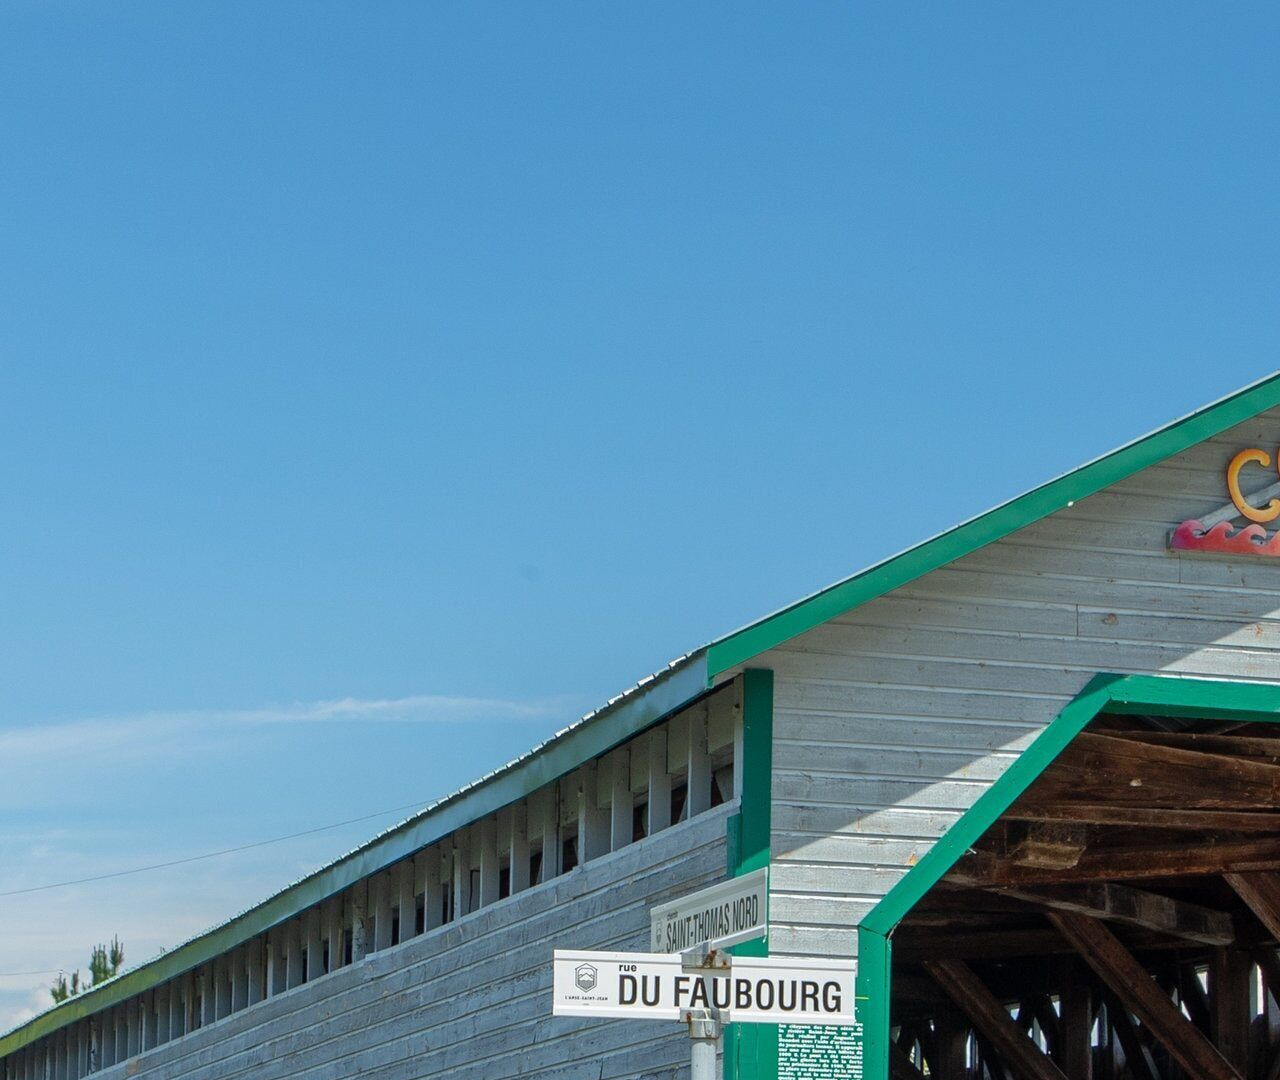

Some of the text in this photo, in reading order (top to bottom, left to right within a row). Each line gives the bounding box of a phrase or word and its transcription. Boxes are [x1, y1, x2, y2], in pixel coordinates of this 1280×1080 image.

[666, 894, 759, 954] SAINT-THOMAS NORD
[619, 963, 637, 972] rue
[619, 974, 842, 1012] DU FAUBOURG
